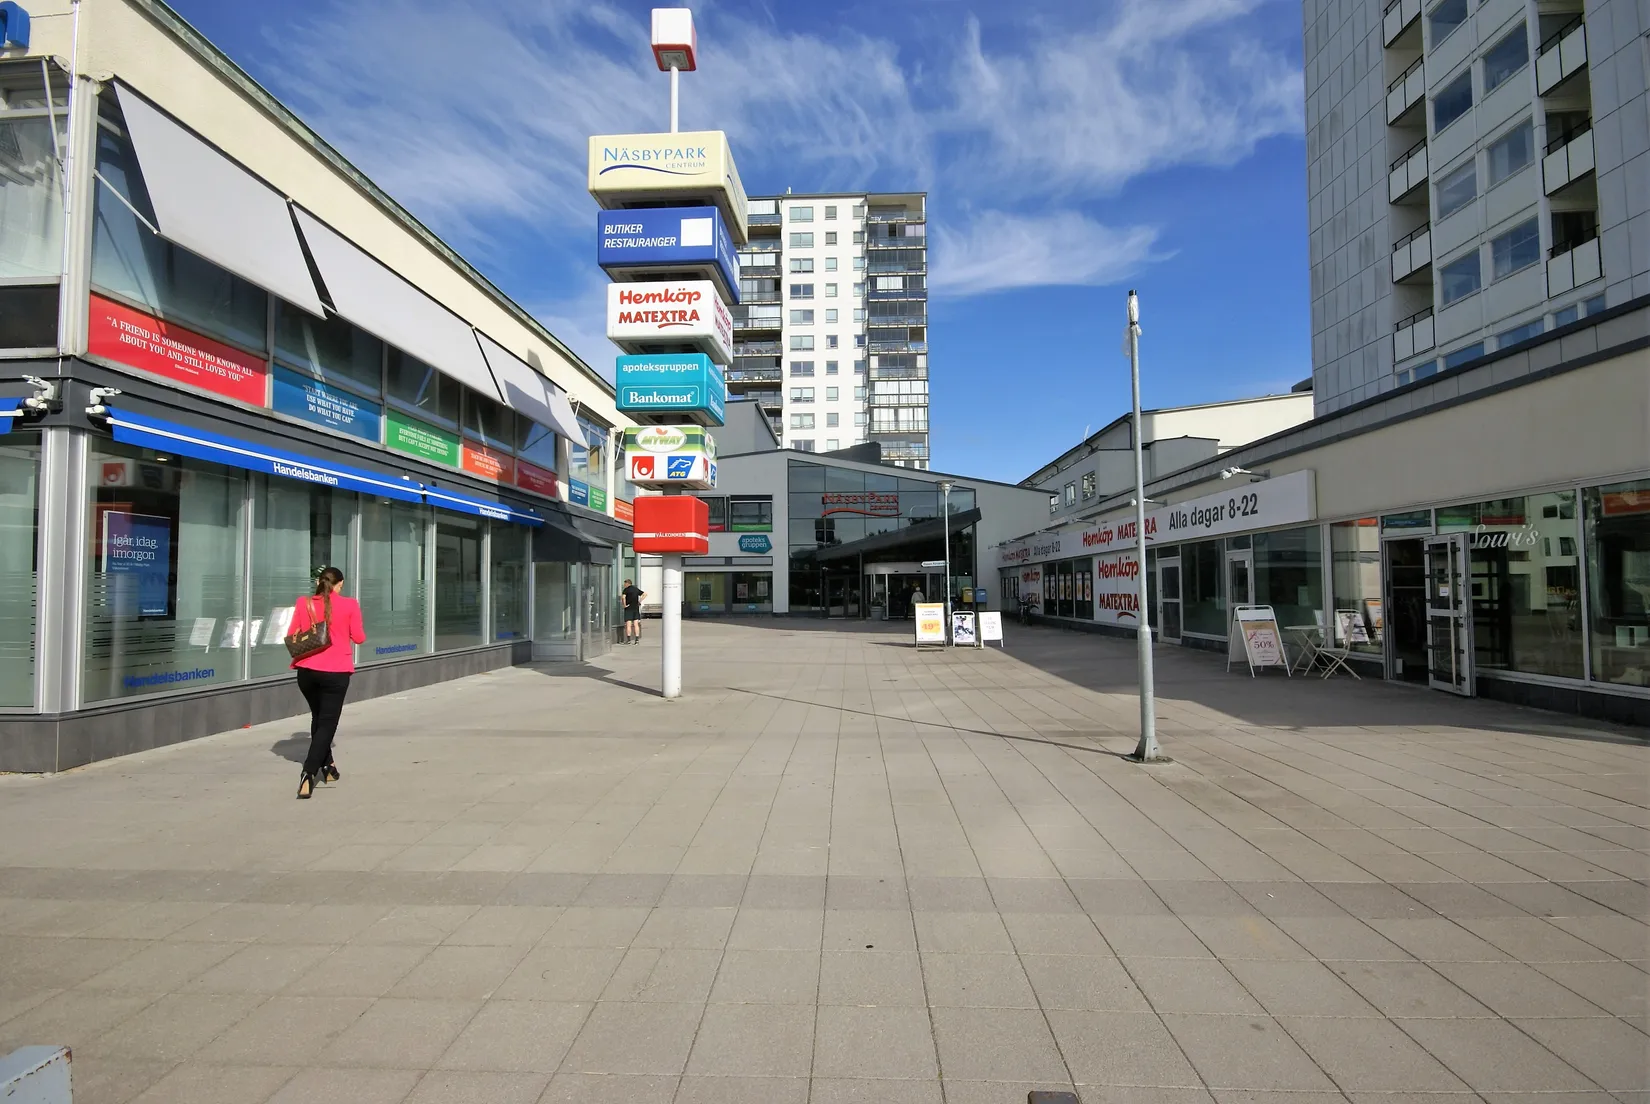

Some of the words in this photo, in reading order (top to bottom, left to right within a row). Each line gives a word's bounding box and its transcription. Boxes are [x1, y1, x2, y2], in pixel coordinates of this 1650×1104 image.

[604, 147, 706, 162] NÄSBYPARK
[604, 224, 643, 234] BUTIKER
[604, 236, 676, 248] RESTAURANGER
[620, 288, 702, 305] Hemköp
[618, 310, 700, 324] MATEXTRA
[120, 320, 150, 339] FRIEND
[152, 330, 160, 342] IS
[162, 336, 196, 356] SOMEONE
[198, 350, 215, 362] WHO
[216, 357, 241, 372] KNOWS
[242, 366, 254, 377] ALL
[120, 333, 147, 349] ABOUT
[150, 344, 166, 356] YOU
[167, 350, 182, 362] AND
[184, 356, 204, 369] STILL
[205, 364, 226, 377] LOVES
[622, 363, 698, 374] apoteksgruppen
[306, 394, 316, 404] USE
[317, 398, 332, 409] WHAT
[332, 404, 342, 412] YOU
[629, 391, 692, 404] Bankomat
[308, 404, 316, 412] DO
[317, 407, 332, 417] WHAT
[332, 412, 342, 420] YOU
[640, 436, 684, 445] MYWAY
[273, 462, 338, 486] Handelsbanken
[1169, 510, 1188, 530] Alla
[1190, 504, 1225, 528] dagar
[1228, 493, 1258, 519] 8-22
[1082, 526, 1113, 547] Hemköp
[1117, 517, 1157, 540] MATERA
[112, 534, 134, 547] Igår,
[136, 536, 158, 549] idag,
[112, 548, 155, 561] imorgon
[1098, 556, 1139, 581] Hemköp
[1099, 593, 1140, 612] MATEXTRA
[375, 643, 417, 655] Handelsbanken
[1254, 641, 1274, 649] 50%
[124, 667, 215, 689] Handelsbanken
